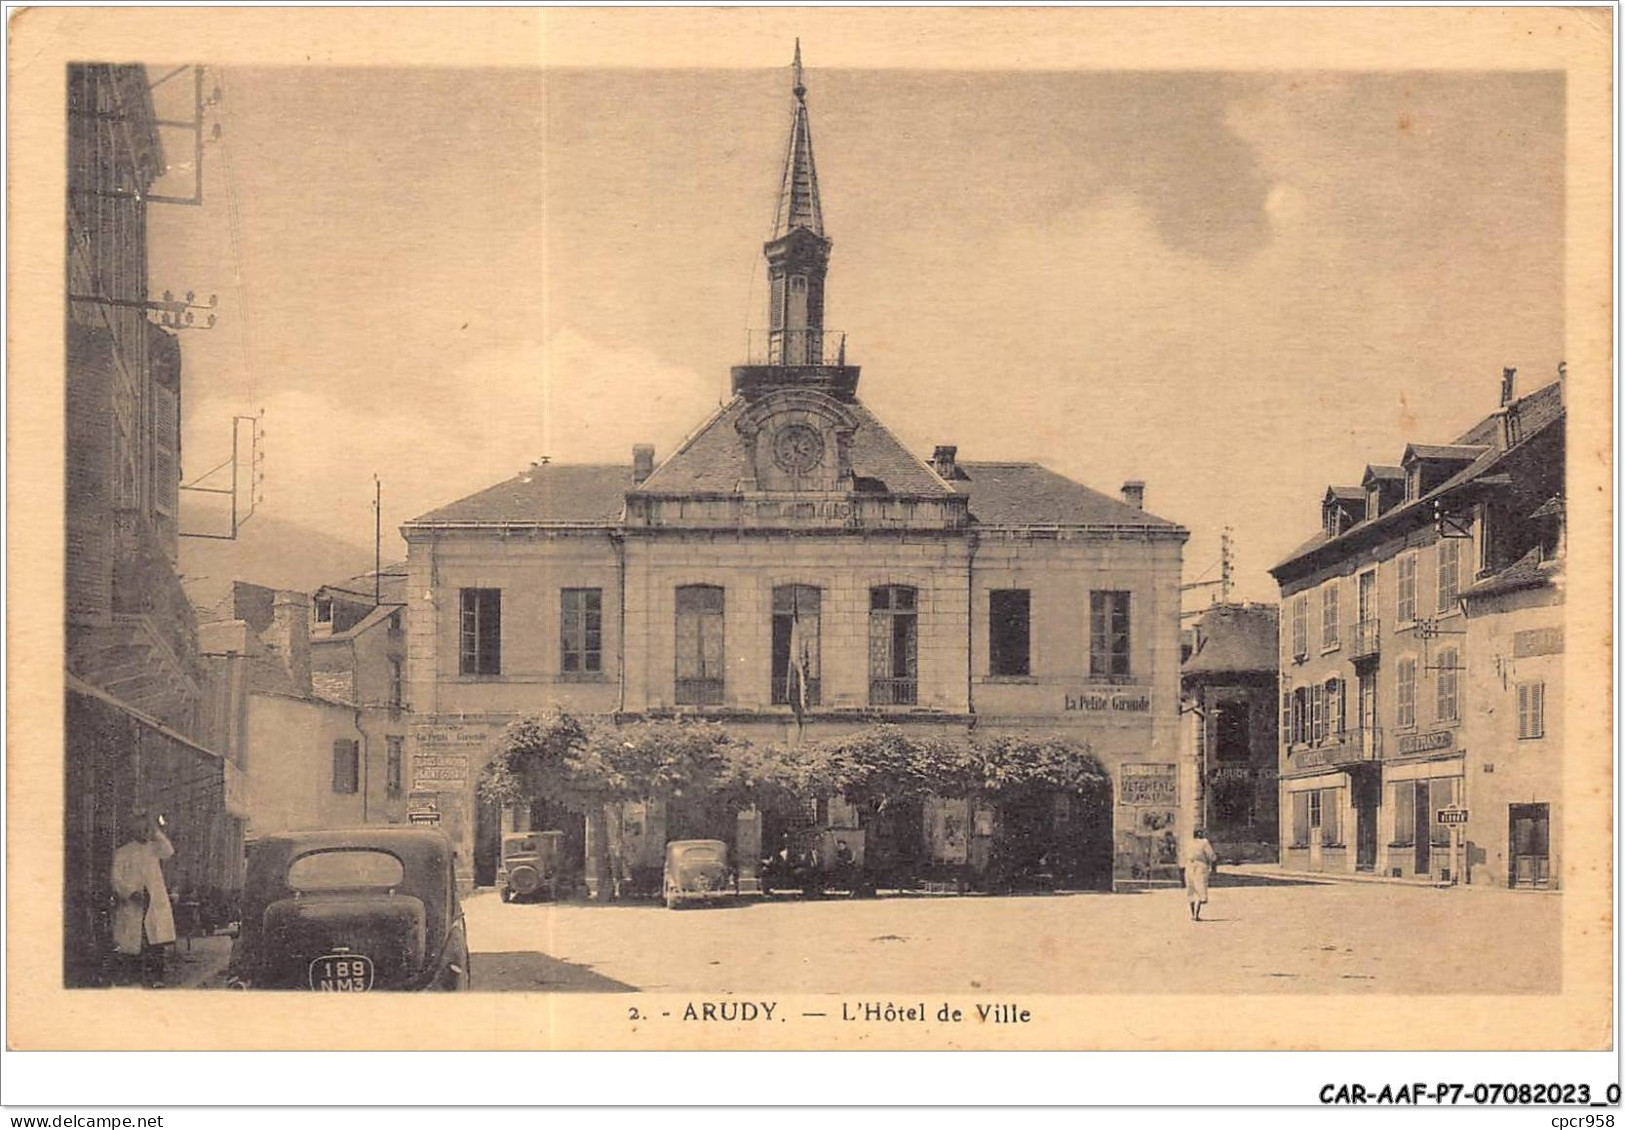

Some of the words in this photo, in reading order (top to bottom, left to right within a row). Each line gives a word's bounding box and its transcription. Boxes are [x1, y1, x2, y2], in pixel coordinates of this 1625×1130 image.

[1065, 694, 1076, 711] La
[1079, 694, 1107, 711] Petite
[1112, 694, 1149, 711] Gironde
[1416, 733, 1446, 750] FRANCE
[325, 960, 364, 977] 189
